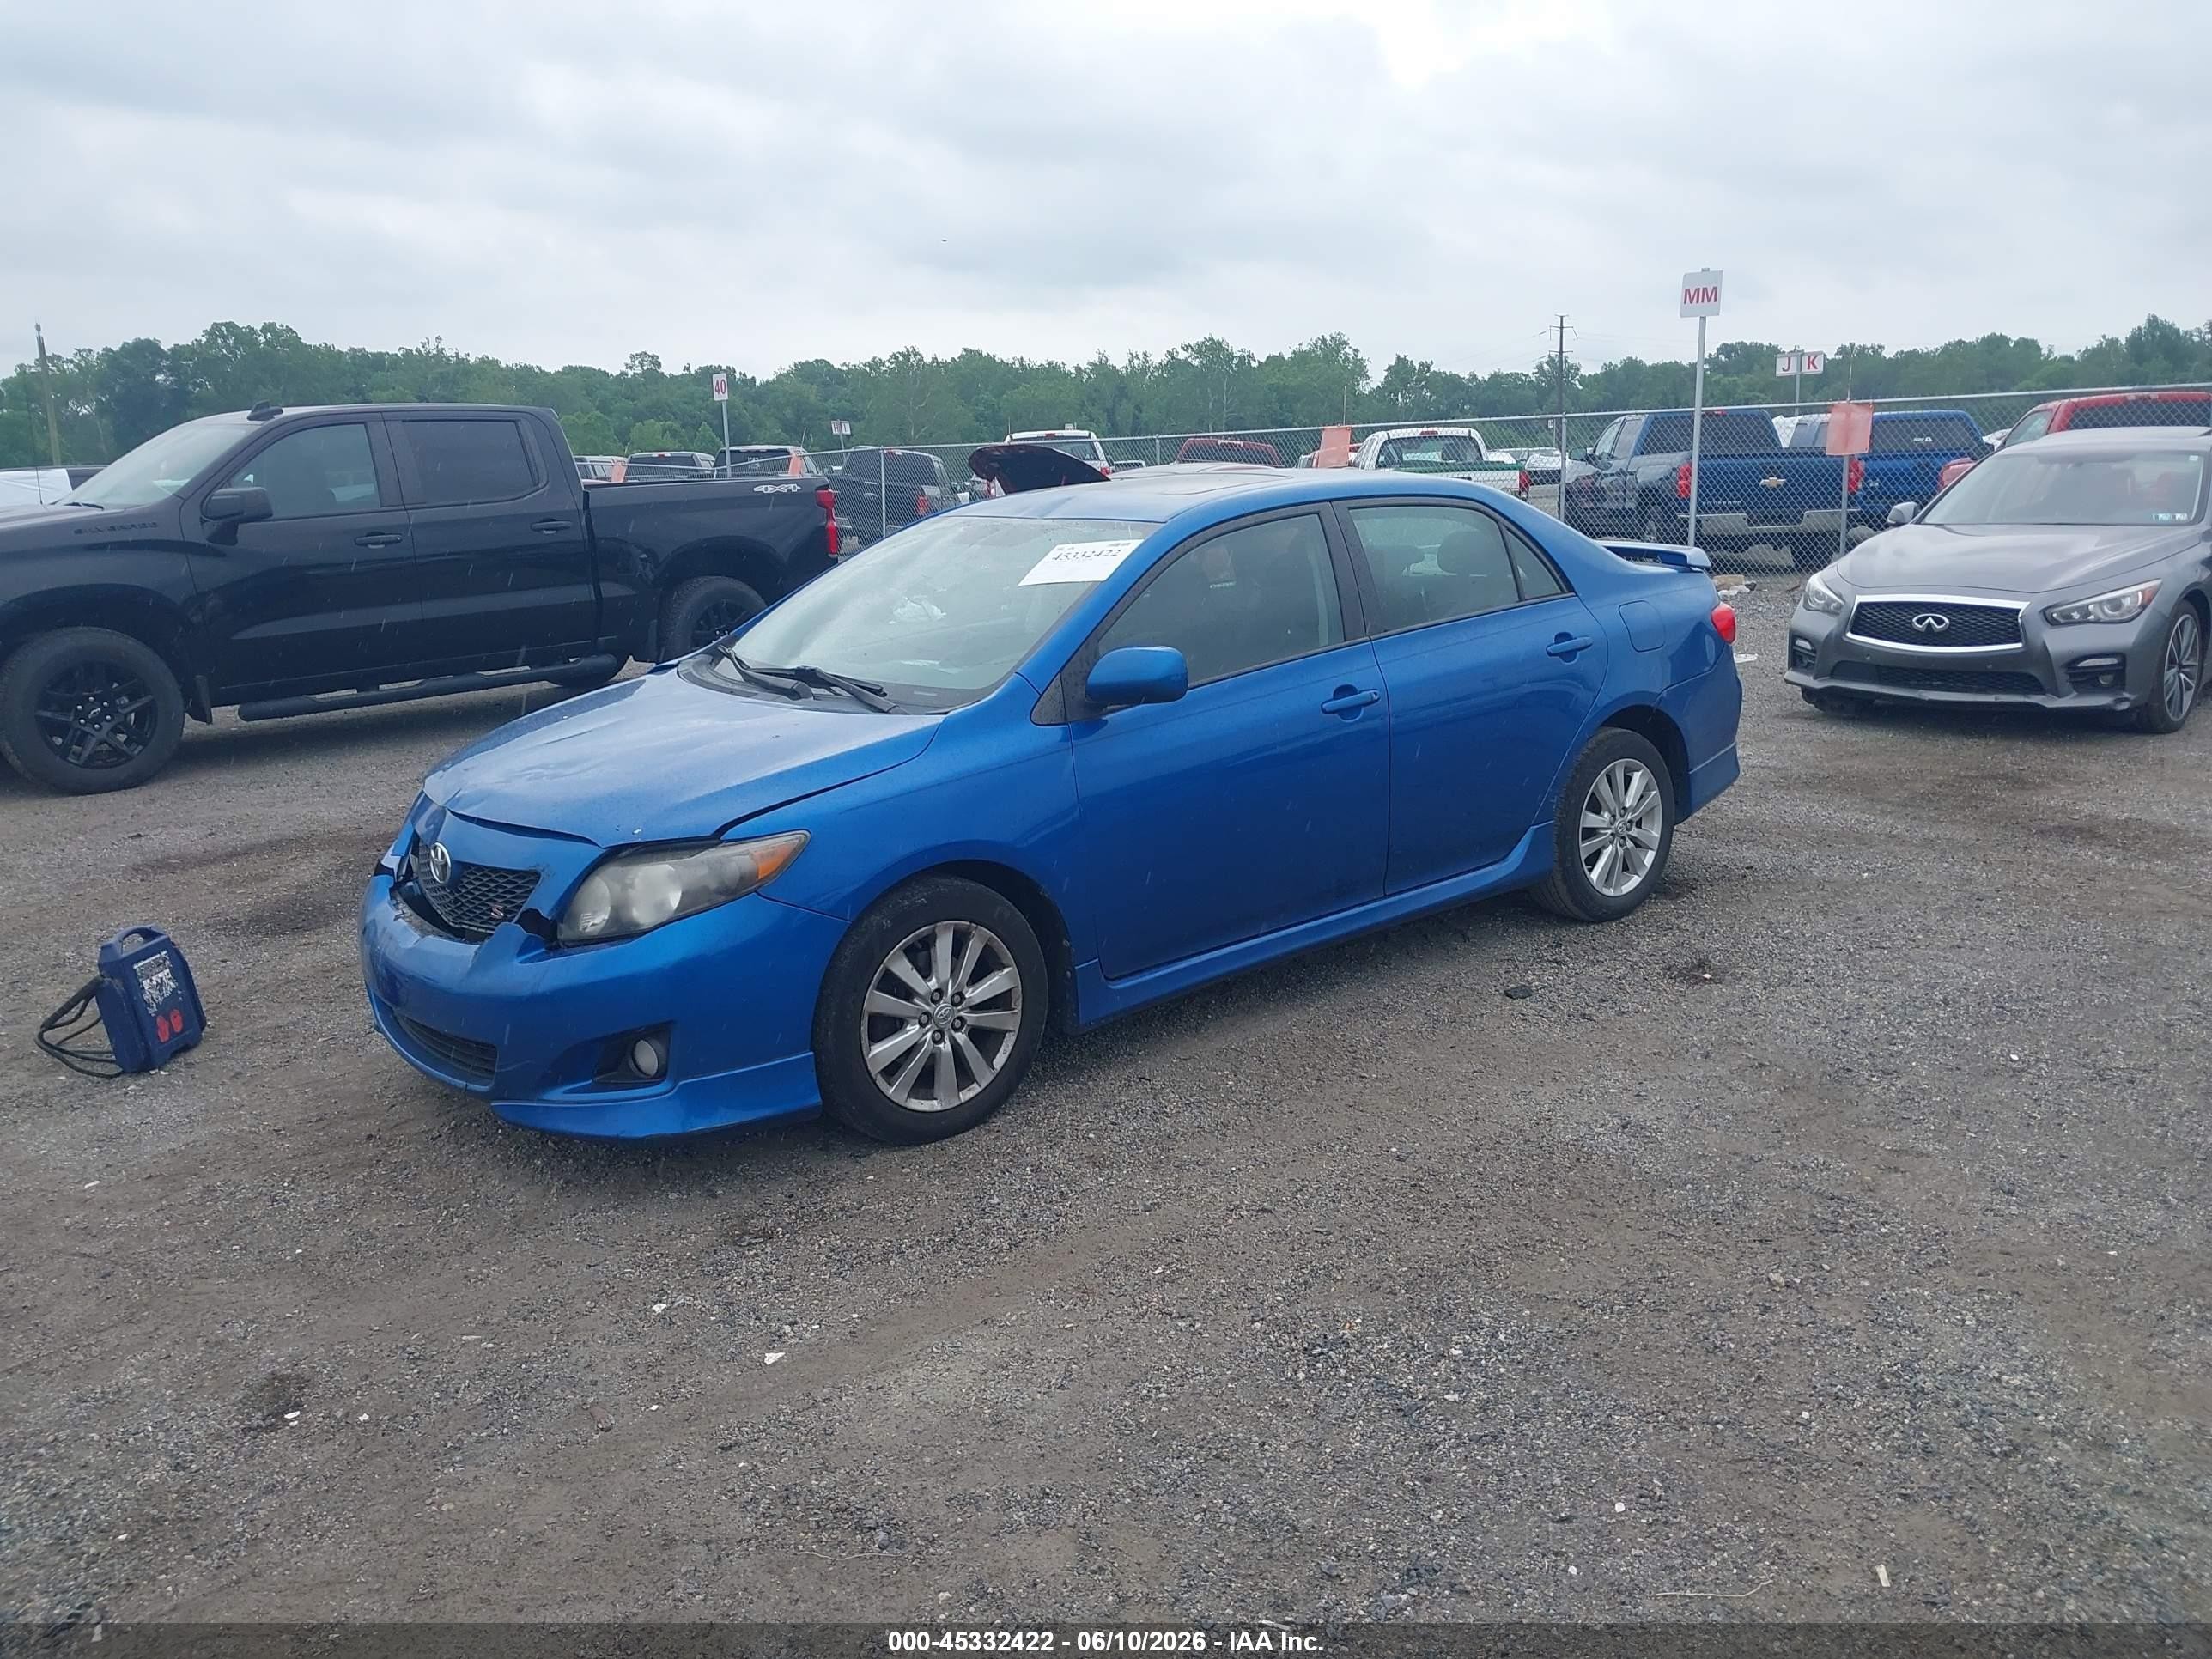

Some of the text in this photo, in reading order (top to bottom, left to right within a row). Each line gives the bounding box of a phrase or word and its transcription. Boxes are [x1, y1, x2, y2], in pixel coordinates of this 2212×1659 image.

[1682, 286, 1718, 305] MM
[1782, 356, 1791, 372] J
[1807, 355, 1819, 370] K
[714, 379, 726, 395] 40
